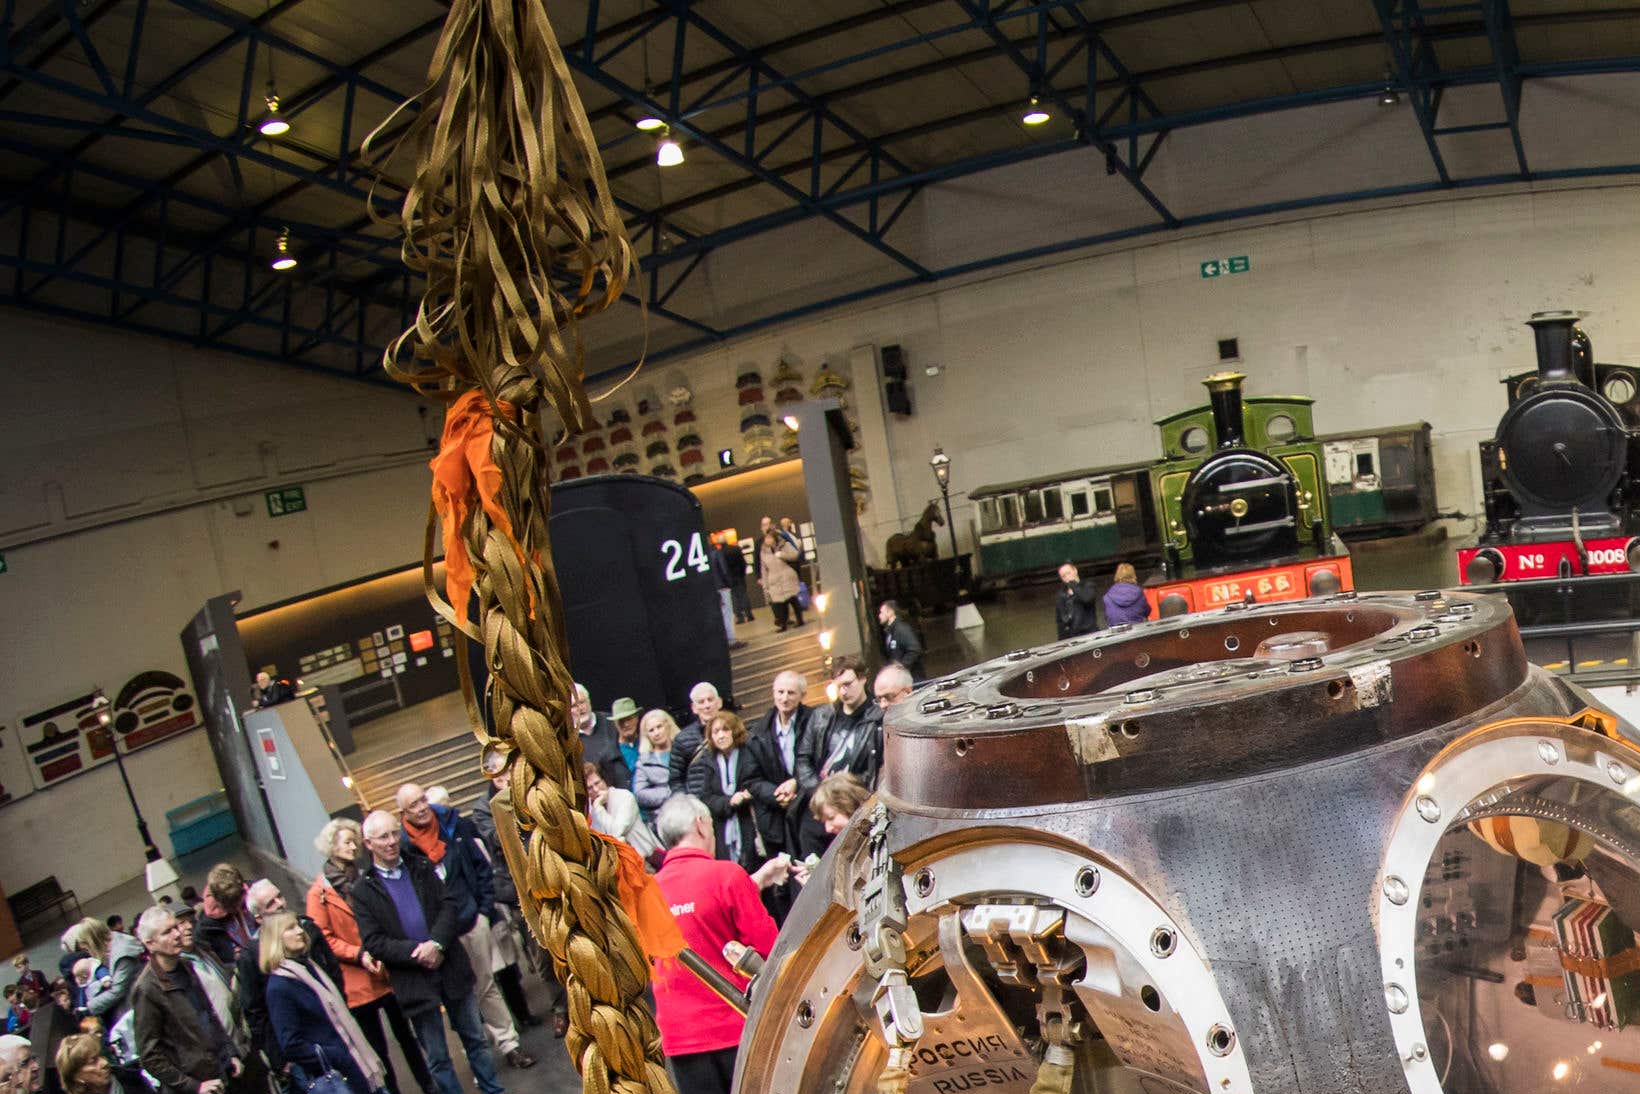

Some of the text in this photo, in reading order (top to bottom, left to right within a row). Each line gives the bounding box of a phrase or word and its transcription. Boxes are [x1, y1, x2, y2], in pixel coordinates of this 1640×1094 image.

[661, 532, 710, 581] 24
[1587, 549, 1625, 565] 1008
[1257, 576, 1290, 595] 66
[908, 1034, 1008, 1070] РОССИЯ
